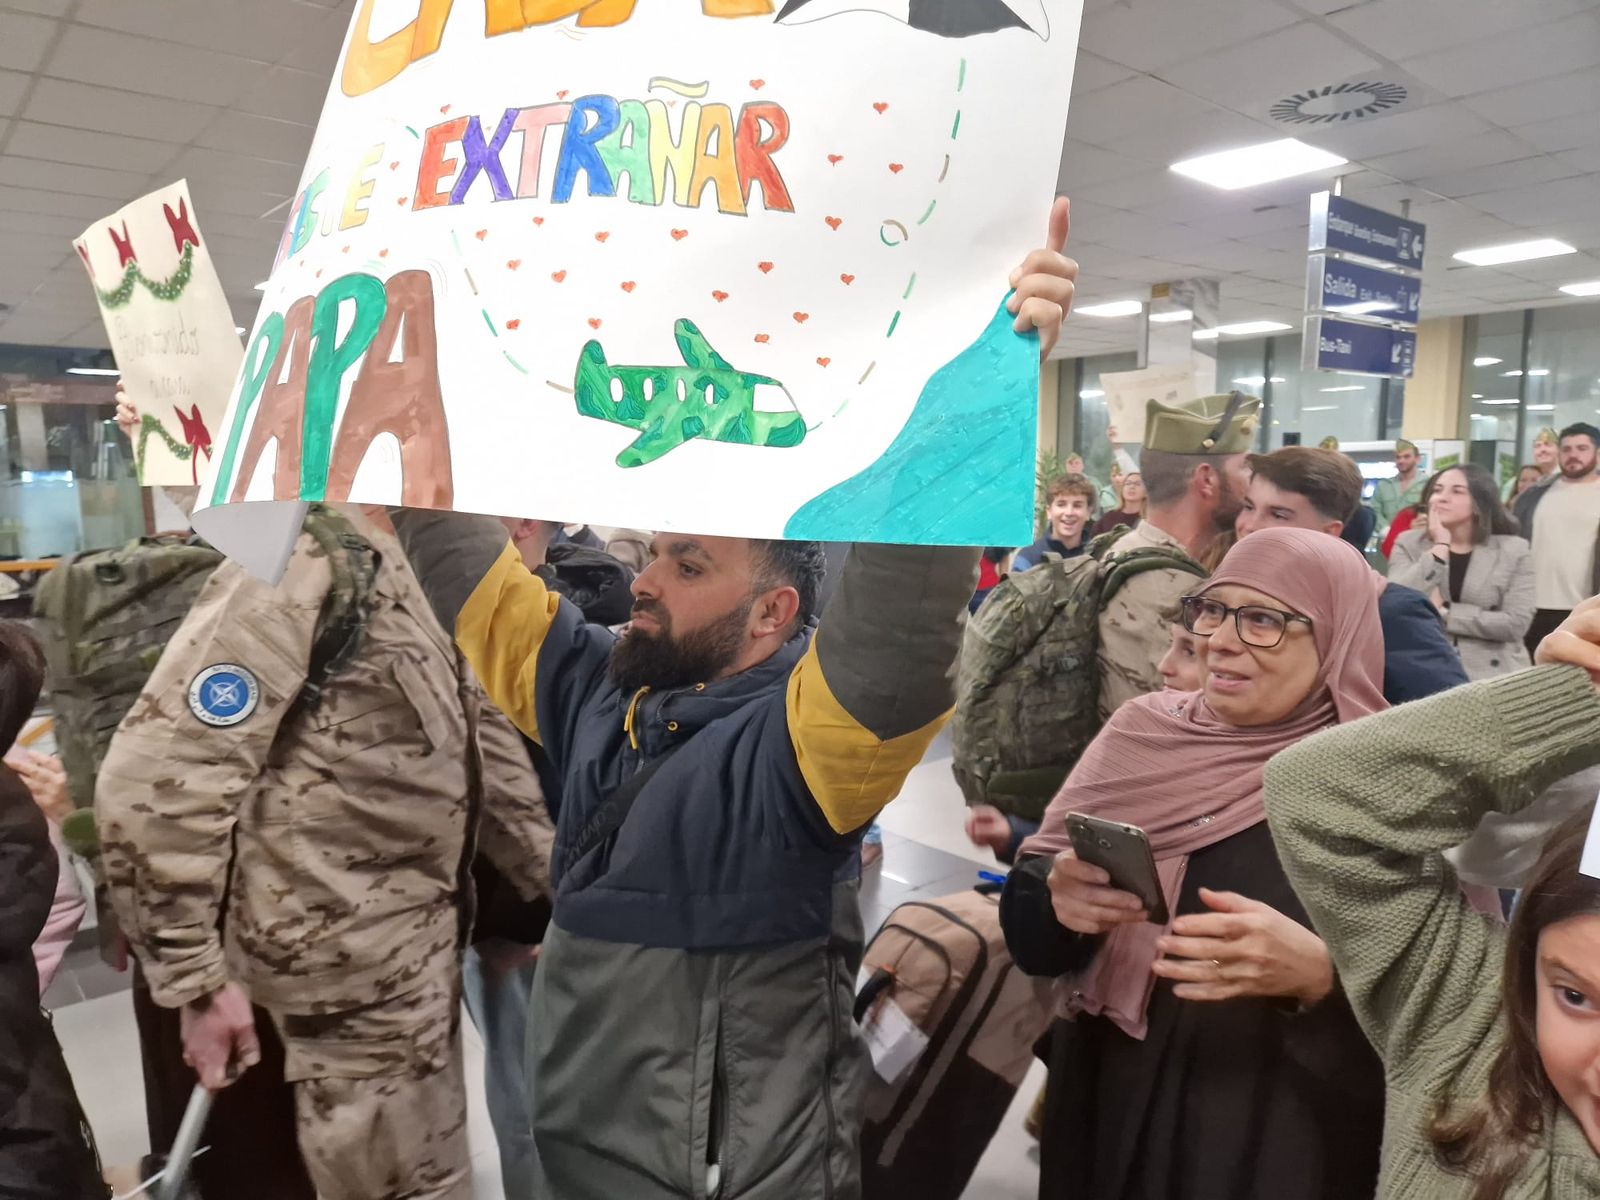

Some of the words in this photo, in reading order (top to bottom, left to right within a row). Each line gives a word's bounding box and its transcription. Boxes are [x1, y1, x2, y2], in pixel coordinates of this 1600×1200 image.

[411, 76, 796, 217] EXTRAÑAR
[1324, 272, 1357, 298] Salida
[1320, 336, 1353, 355] Bus-Taxi
[209, 268, 455, 511] PAPA
